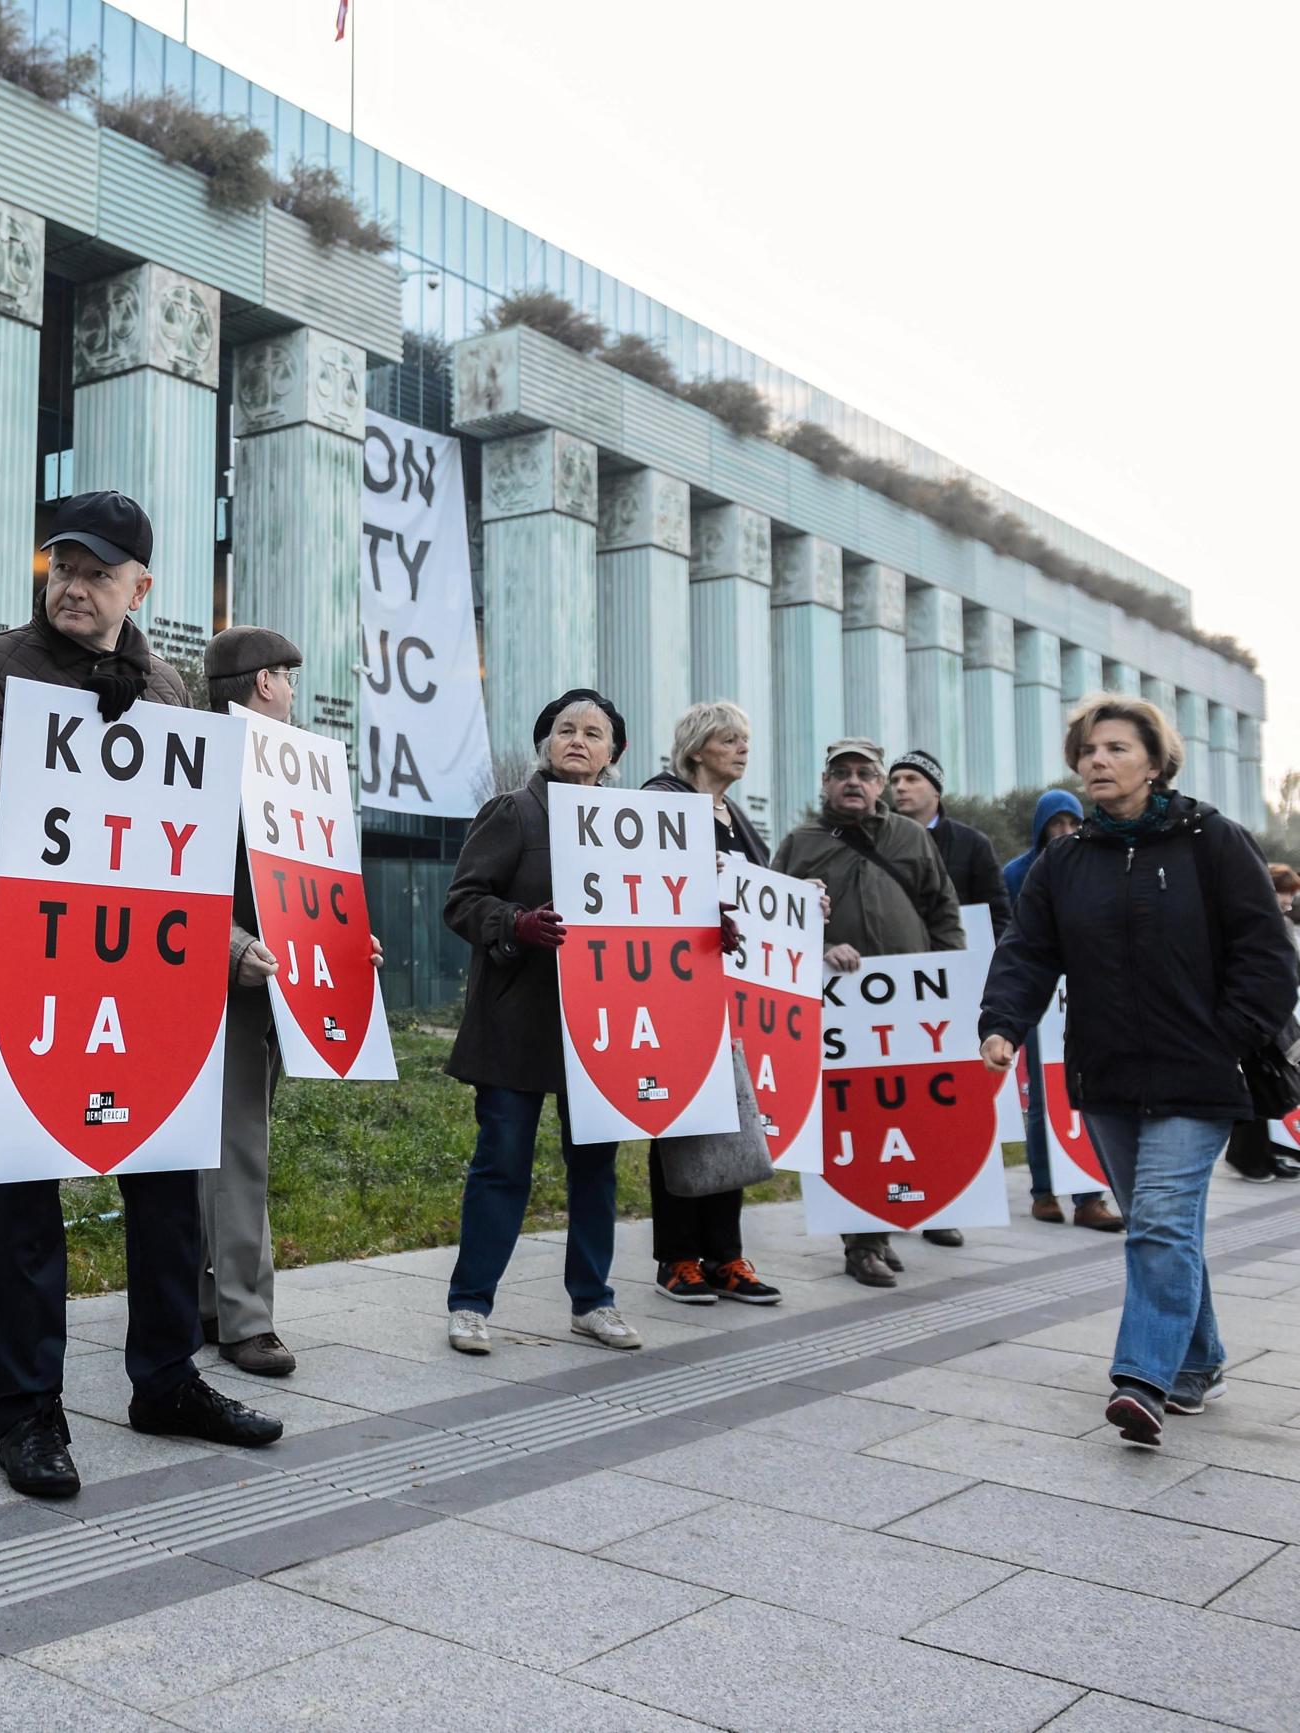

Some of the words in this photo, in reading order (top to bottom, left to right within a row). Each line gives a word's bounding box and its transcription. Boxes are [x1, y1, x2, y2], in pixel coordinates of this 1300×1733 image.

[363, 425, 435, 508] ON
[363, 522, 432, 602] TY
[361, 623, 438, 704] UC
[45, 712, 207, 790] KON
[252, 730, 332, 795] KON
[361, 726, 434, 803] JA
[41, 807, 199, 876] STY
[263, 800, 336, 858] STY
[577, 805, 688, 851] KON
[271, 869, 348, 925] TUC
[583, 872, 689, 915] STY
[735, 876, 806, 931] KON
[38, 900, 188, 965] TUC
[287, 940, 335, 989] JA
[587, 939, 693, 982] TUC
[735, 933, 804, 983] STY
[822, 968, 949, 1008] KON
[29, 996, 127, 1056] JA
[592, 1006, 661, 1052] JA
[734, 990, 802, 1041] TUC
[823, 1020, 950, 1060] STY
[757, 1054, 777, 1093] A
[828, 1072, 957, 1113] TUC
[91, 1096, 112, 1106] AKCJA
[1067, 1110, 1082, 1139] J
[833, 1127, 916, 1167] JA
